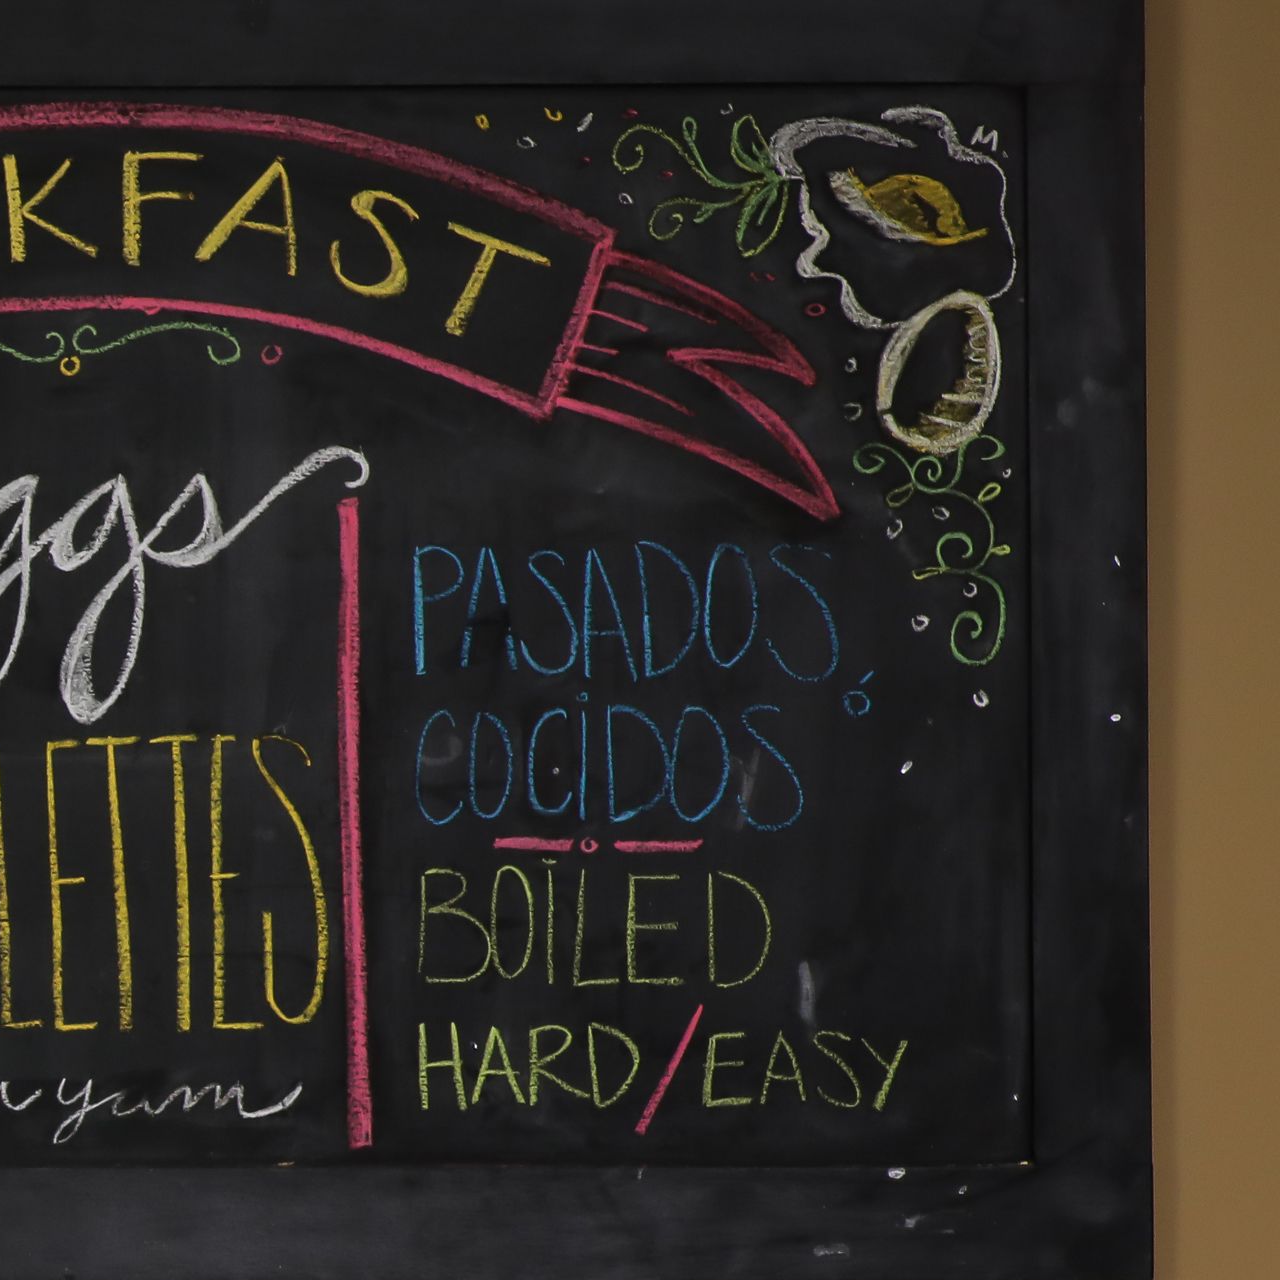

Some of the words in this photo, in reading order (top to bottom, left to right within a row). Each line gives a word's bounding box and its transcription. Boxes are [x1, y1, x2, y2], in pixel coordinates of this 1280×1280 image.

[413, 541, 839, 681] PASADOS
[418, 859, 772, 988] BOILED
[52, 1077, 302, 1144] yum
